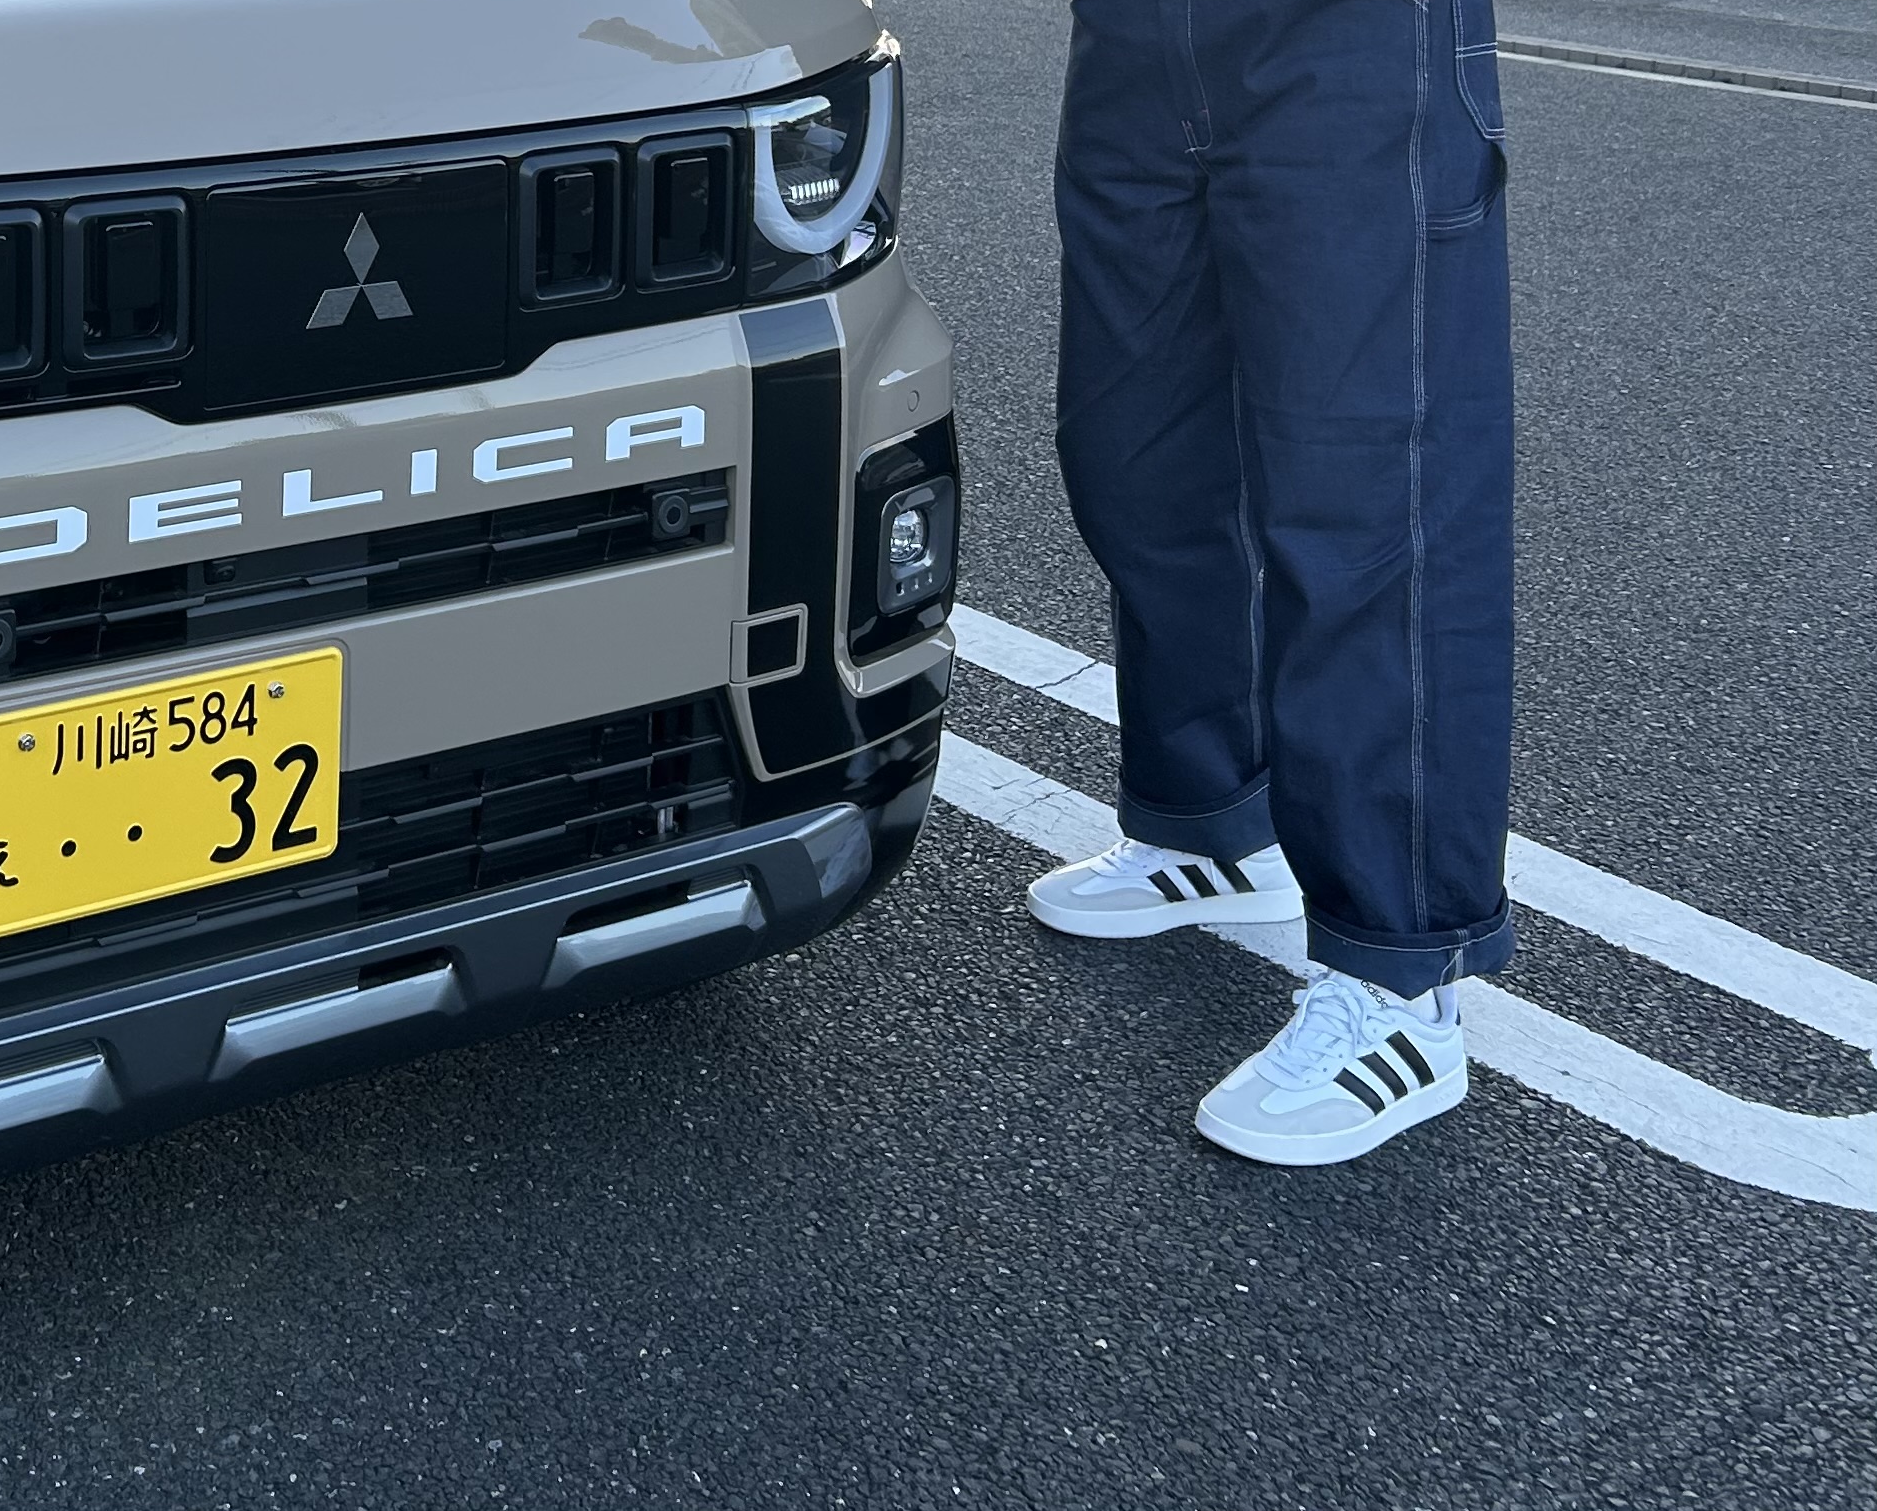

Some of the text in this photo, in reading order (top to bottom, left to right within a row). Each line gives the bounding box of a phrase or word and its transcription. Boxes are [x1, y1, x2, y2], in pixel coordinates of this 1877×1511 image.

[52, 683, 259, 776] 川崎 584
[1360, 979, 1390, 1010] adida
